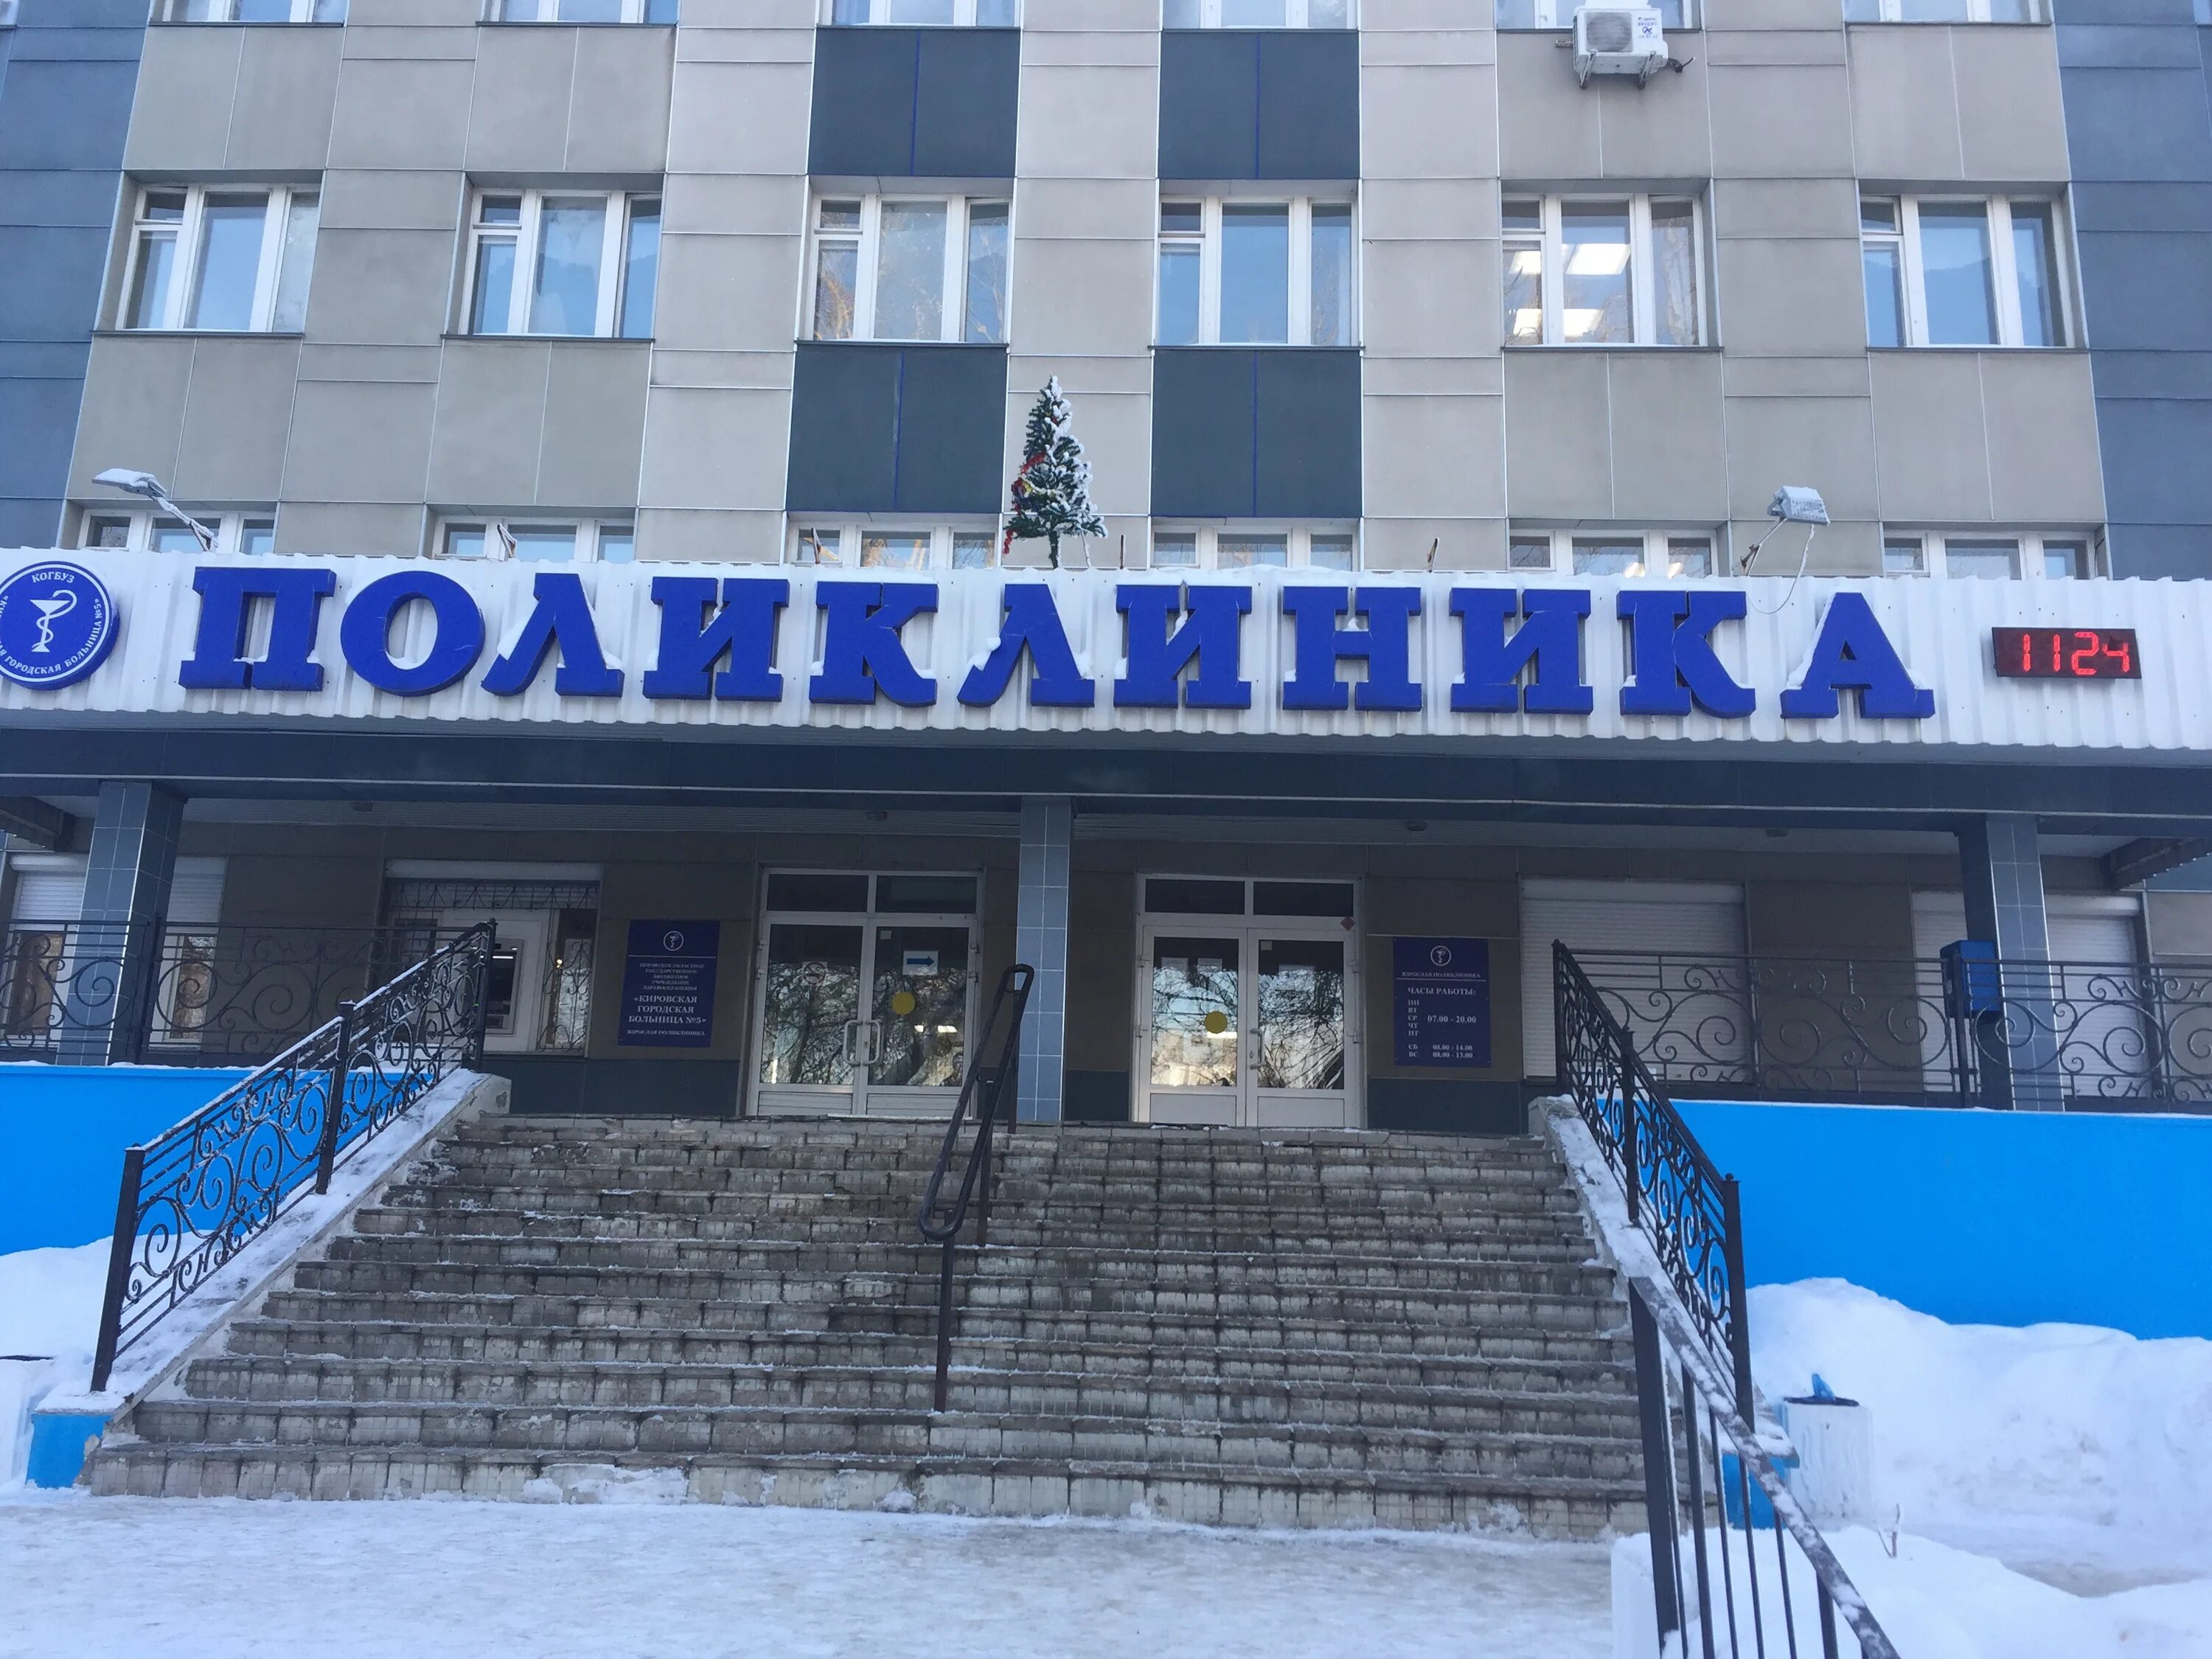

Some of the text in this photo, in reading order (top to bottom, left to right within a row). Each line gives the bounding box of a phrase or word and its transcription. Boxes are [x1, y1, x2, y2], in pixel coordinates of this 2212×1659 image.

[32, 571, 75, 584] КОГБУЗ
[178, 566, 1935, 719] ПОЛИКЛИНИКА
[4, 655, 62, 675] ГОРОДСКАЯ
[64, 620, 102, 668] БОЛЬНИЦА
[1436, 987, 1476, 995] РАБОТЫ:
[637, 1005, 695, 1014] ГОРОДСКАЯ
[628, 1015, 684, 1024] БОЛЬНИЦА
[1427, 1015, 1449, 1023] 07.00
[1455, 1015, 1477, 1023] 20.00
